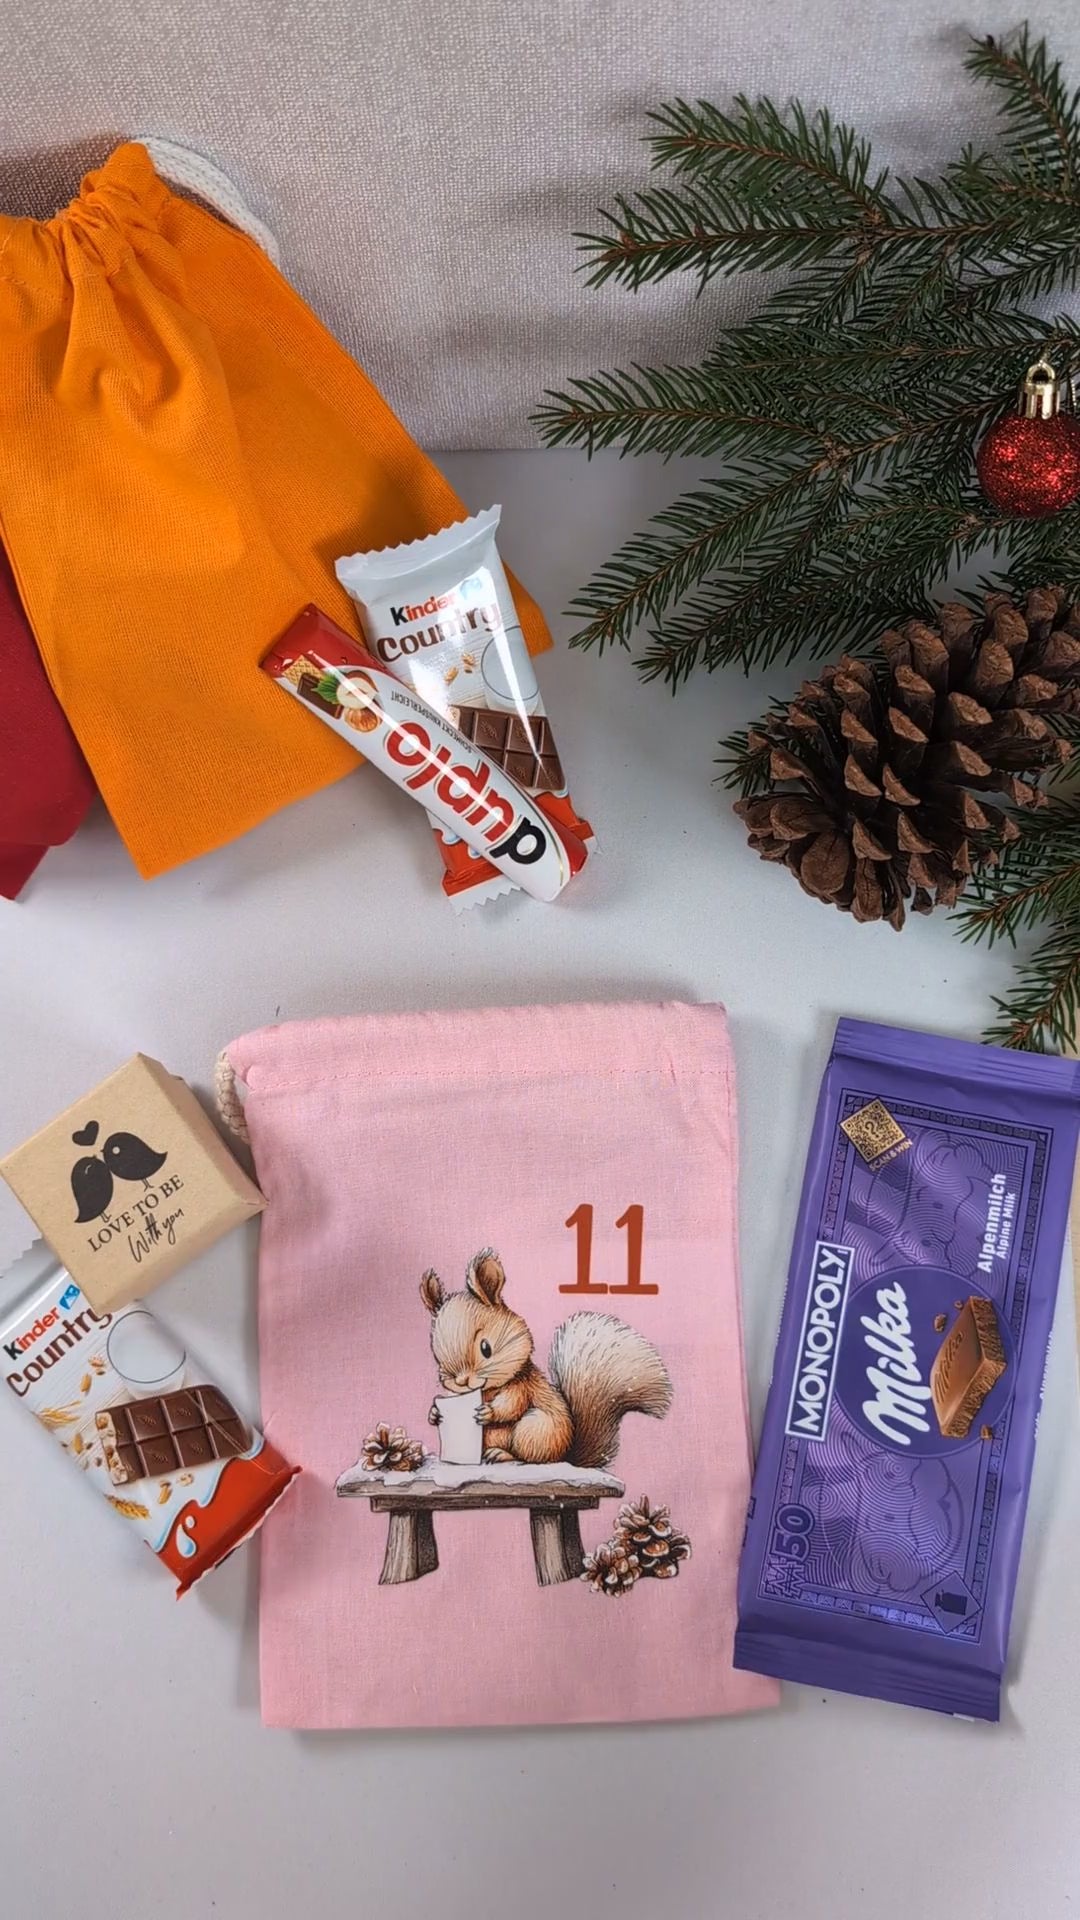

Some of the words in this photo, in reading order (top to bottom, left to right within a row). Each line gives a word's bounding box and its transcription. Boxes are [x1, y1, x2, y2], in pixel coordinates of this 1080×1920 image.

[386, 721, 547, 865] duplo
[869, 1152, 892, 1172] SCAN
[87, 1211, 135, 1252] LOVE
[133, 1193, 159, 1216] TO
[159, 1174, 184, 1199] BE
[128, 1212, 162, 1263] With
[162, 1208, 184, 1245] you
[977, 1173, 1007, 1273] Alpenmilch
[996, 1220, 1012, 1260] Alpine
[1002, 1192, 1016, 1219] Milk
[558, 1203, 659, 1295] 11
[3, 1307, 60, 1361] Kinder
[6, 1308, 113, 1398] Country
[793, 1247, 847, 1433] MONOPOLY
[862, 1281, 932, 1446] Milka
